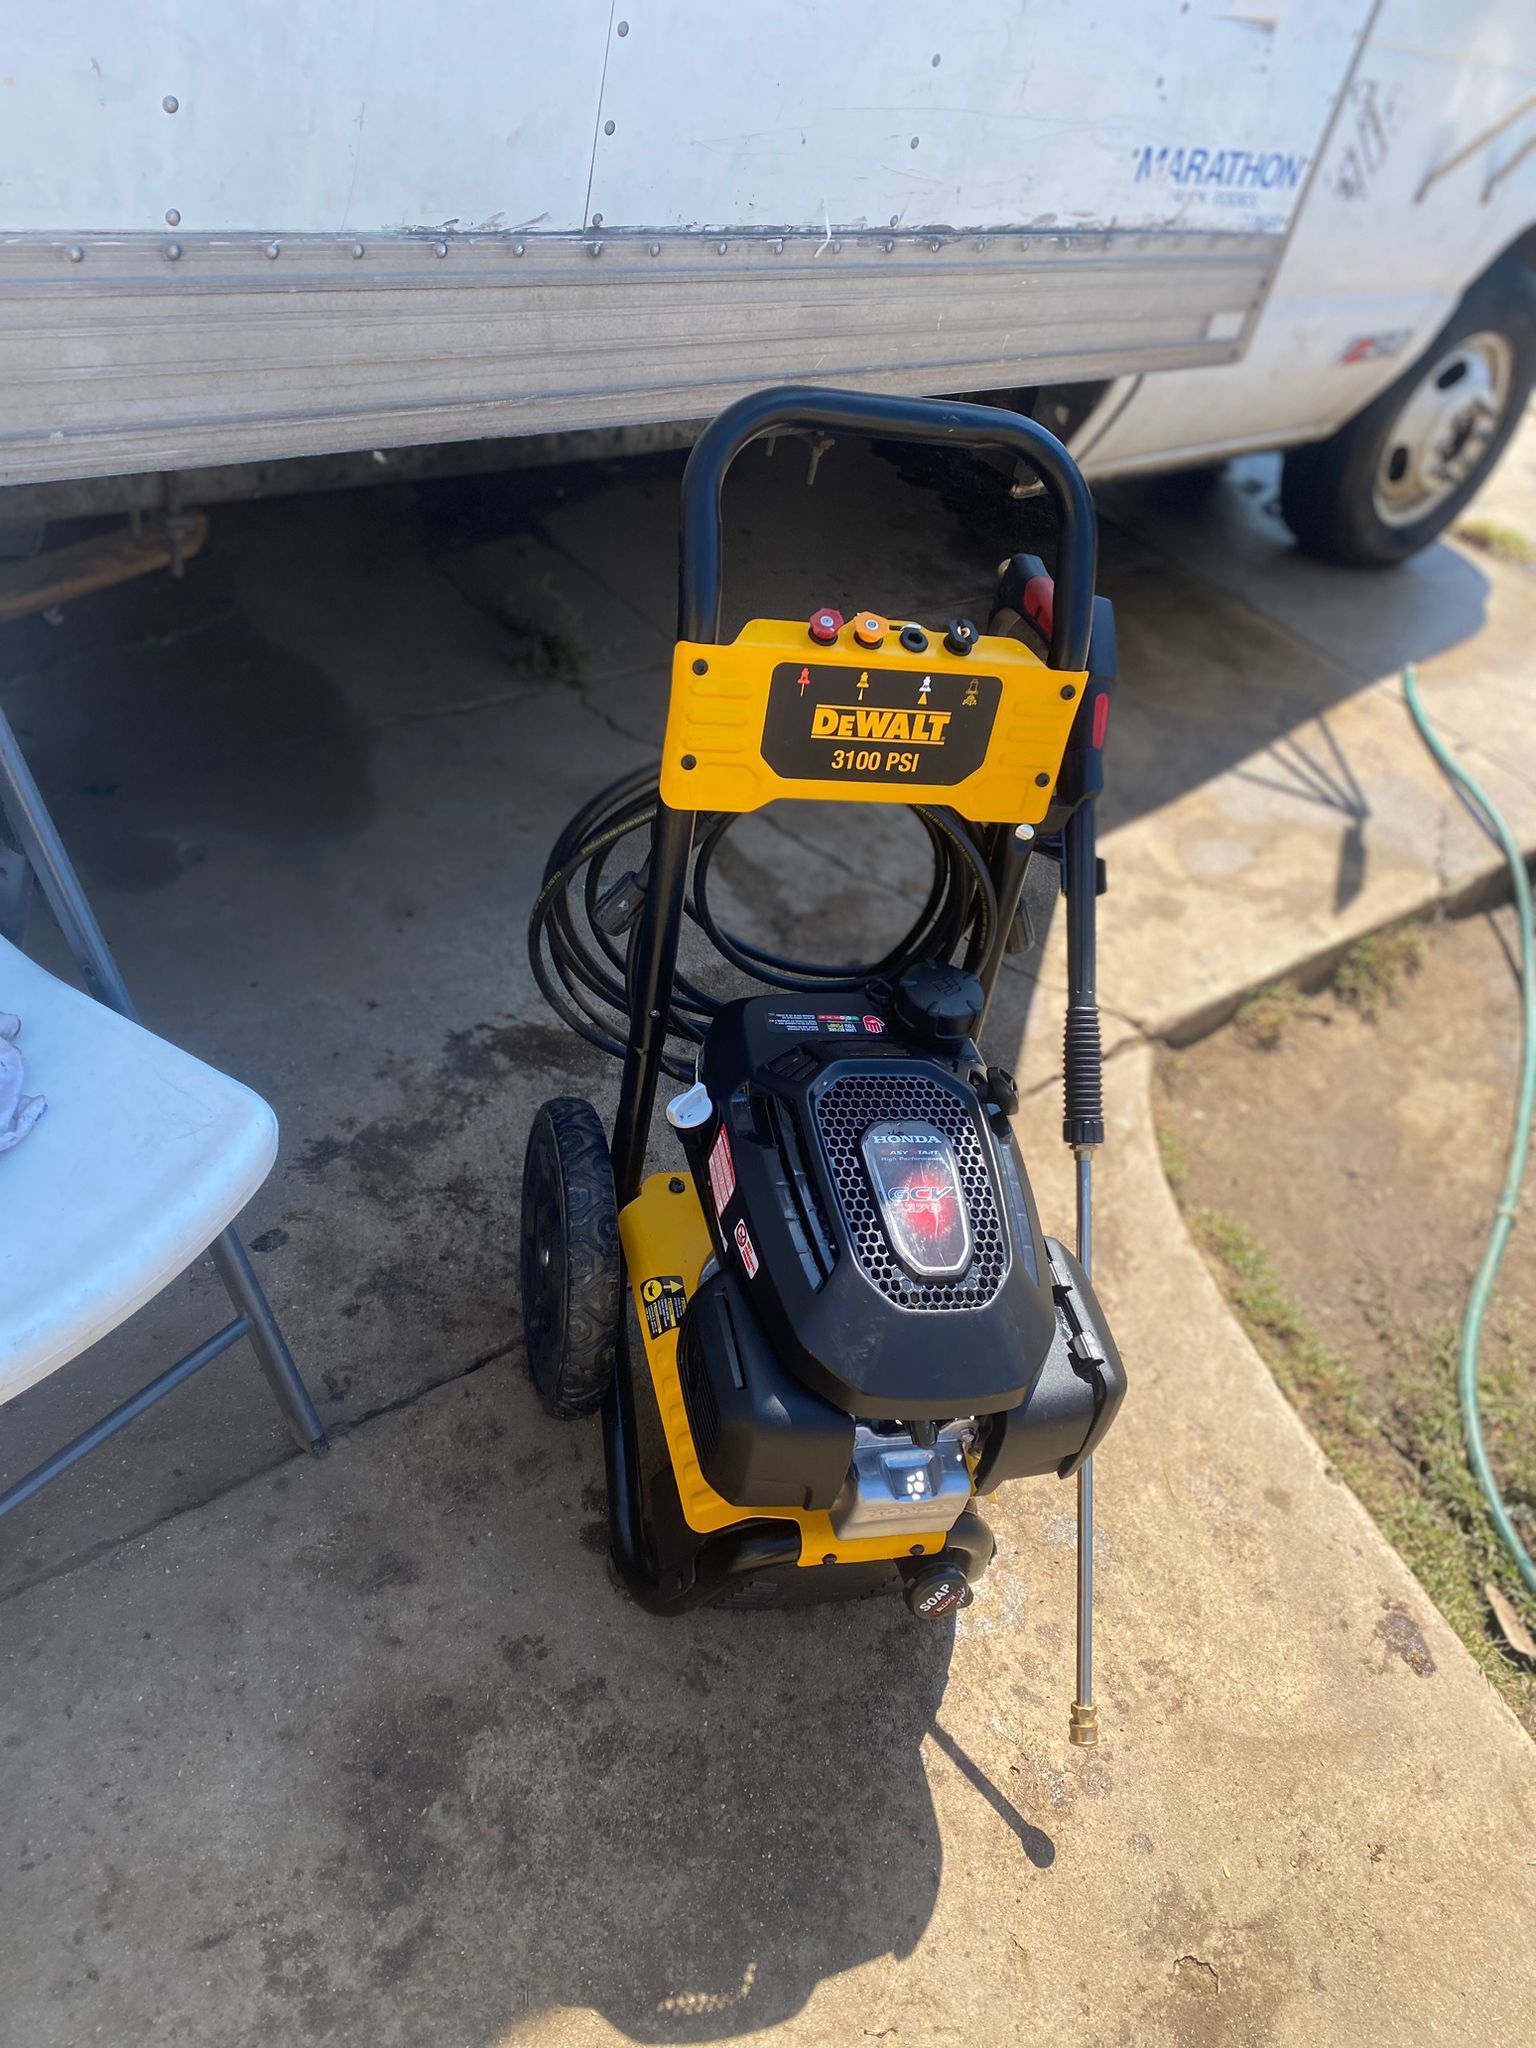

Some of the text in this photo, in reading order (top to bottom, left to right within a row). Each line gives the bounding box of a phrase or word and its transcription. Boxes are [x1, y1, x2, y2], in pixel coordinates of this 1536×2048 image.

[1134, 146, 1306, 188] MARATHON
[831, 749, 920, 773] 3100 PSI
[872, 1135, 942, 1144] HONDA
[888, 1186, 954, 1202] GCV
[920, 1583, 950, 1612] SOAP
